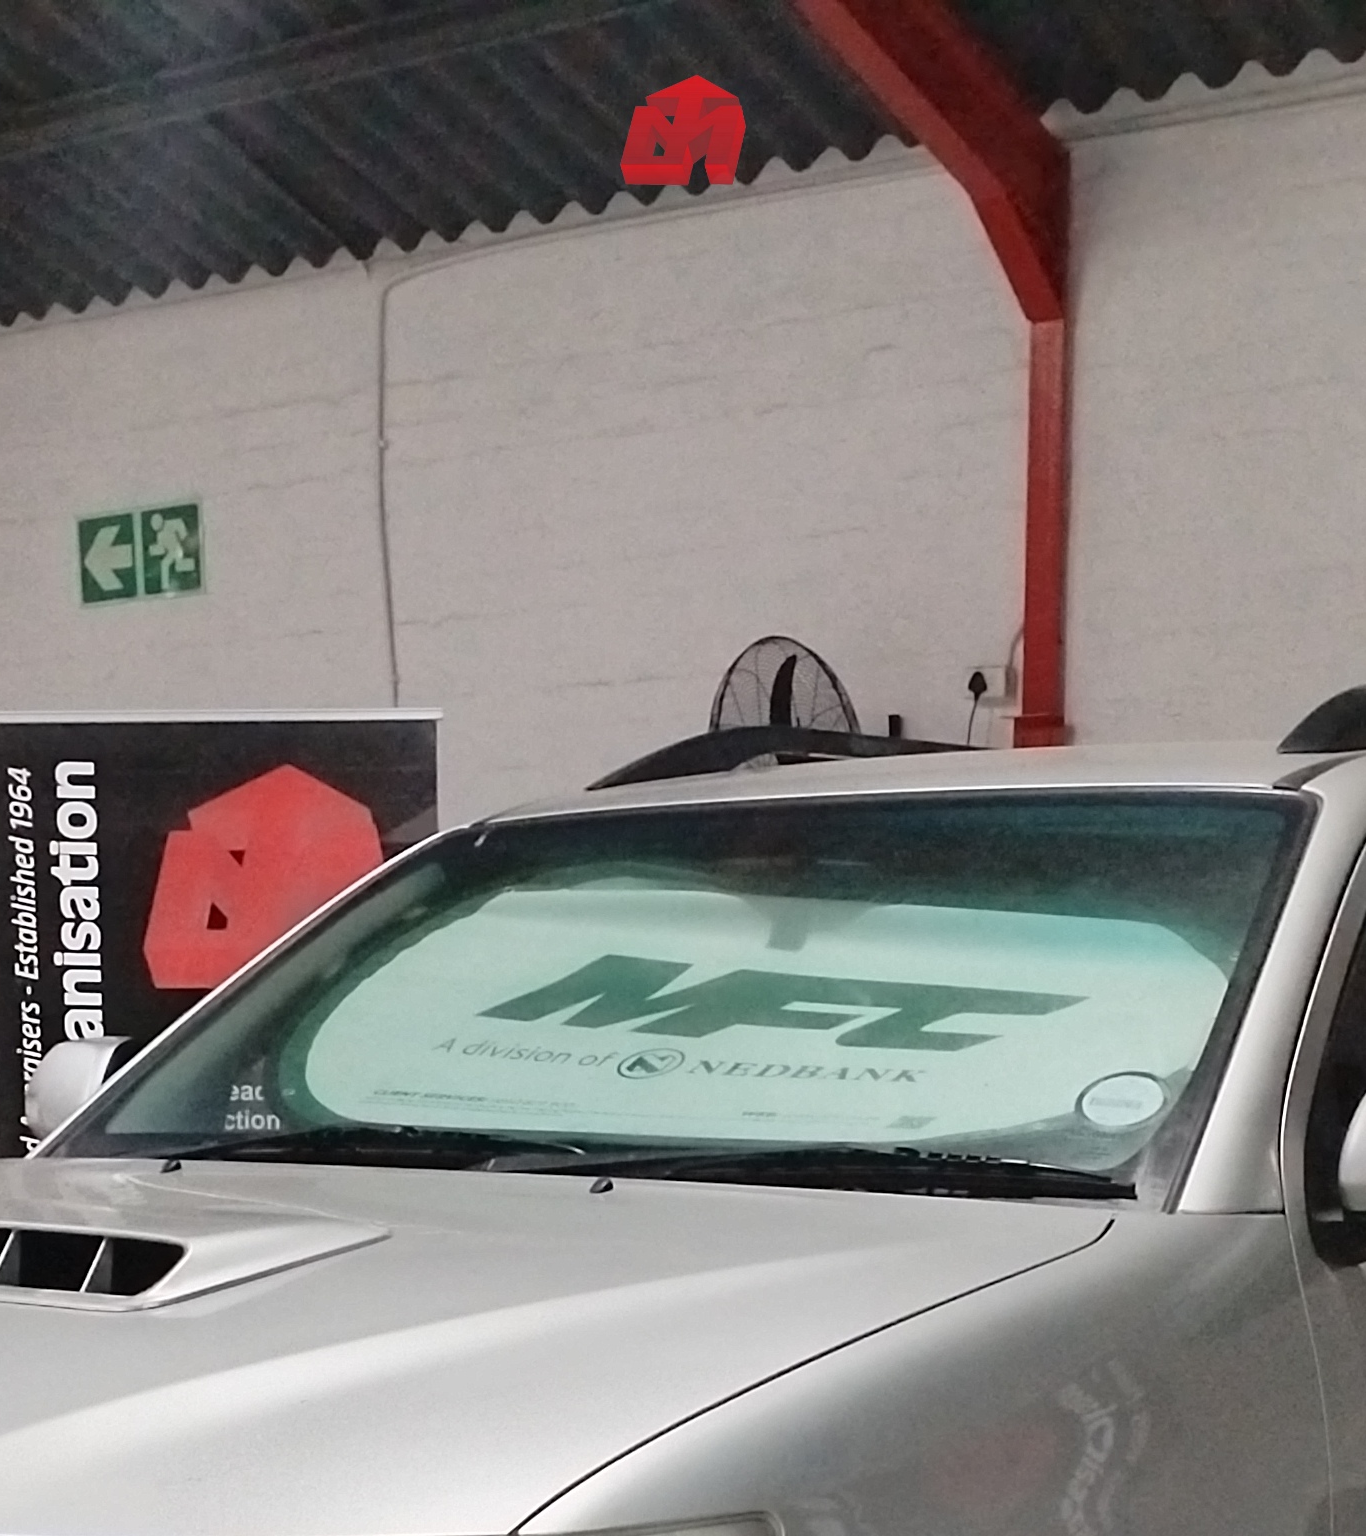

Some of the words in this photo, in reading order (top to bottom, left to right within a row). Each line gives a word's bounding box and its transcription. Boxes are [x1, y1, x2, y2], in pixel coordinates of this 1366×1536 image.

[6, 766, 33, 830] 1964
[7, 835, 39, 980] Established
[474, 953, 1092, 1052] MFC
[433, 1037, 457, 1054] A
[461, 1039, 573, 1065] division
[577, 1051, 621, 1067] of
[687, 1059, 928, 1083] NEDBANK
